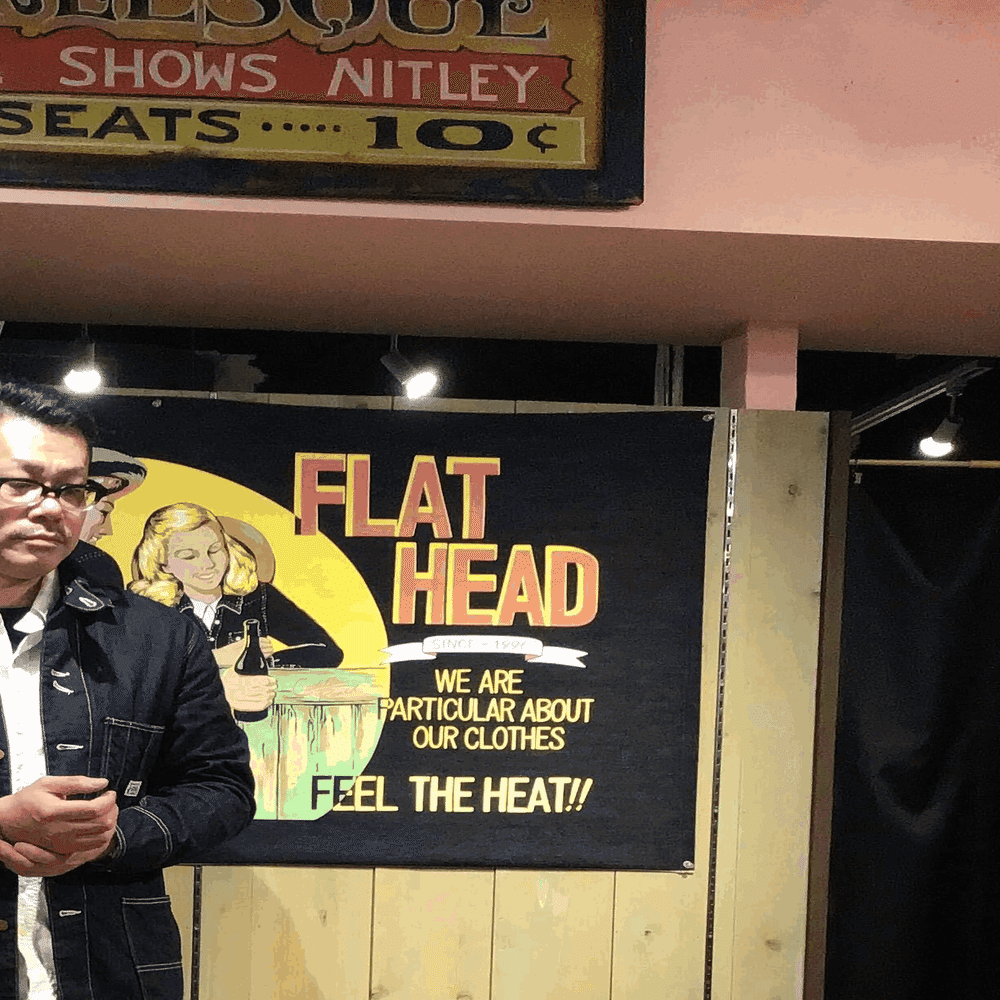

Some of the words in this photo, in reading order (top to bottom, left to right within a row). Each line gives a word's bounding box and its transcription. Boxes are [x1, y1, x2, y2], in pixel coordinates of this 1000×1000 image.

[58, 45, 278, 93] SHOWS
[326, 57, 540, 104] NITLEY
[294, 452, 501, 539] FLAT
[392, 541, 600, 627] HEAD
[434, 668, 472, 694] WE
[478, 668, 525, 694] ARE
[378, 696, 516, 722] PARTICULAR
[520, 697, 595, 723] ABOUT
[412, 725, 460, 750] OUR
[463, 726, 566, 751] CLOTHES
[311, 775, 399, 812] FEEL
[409, 776, 475, 813] THE
[482, 776, 593, 813] HEAT!!
